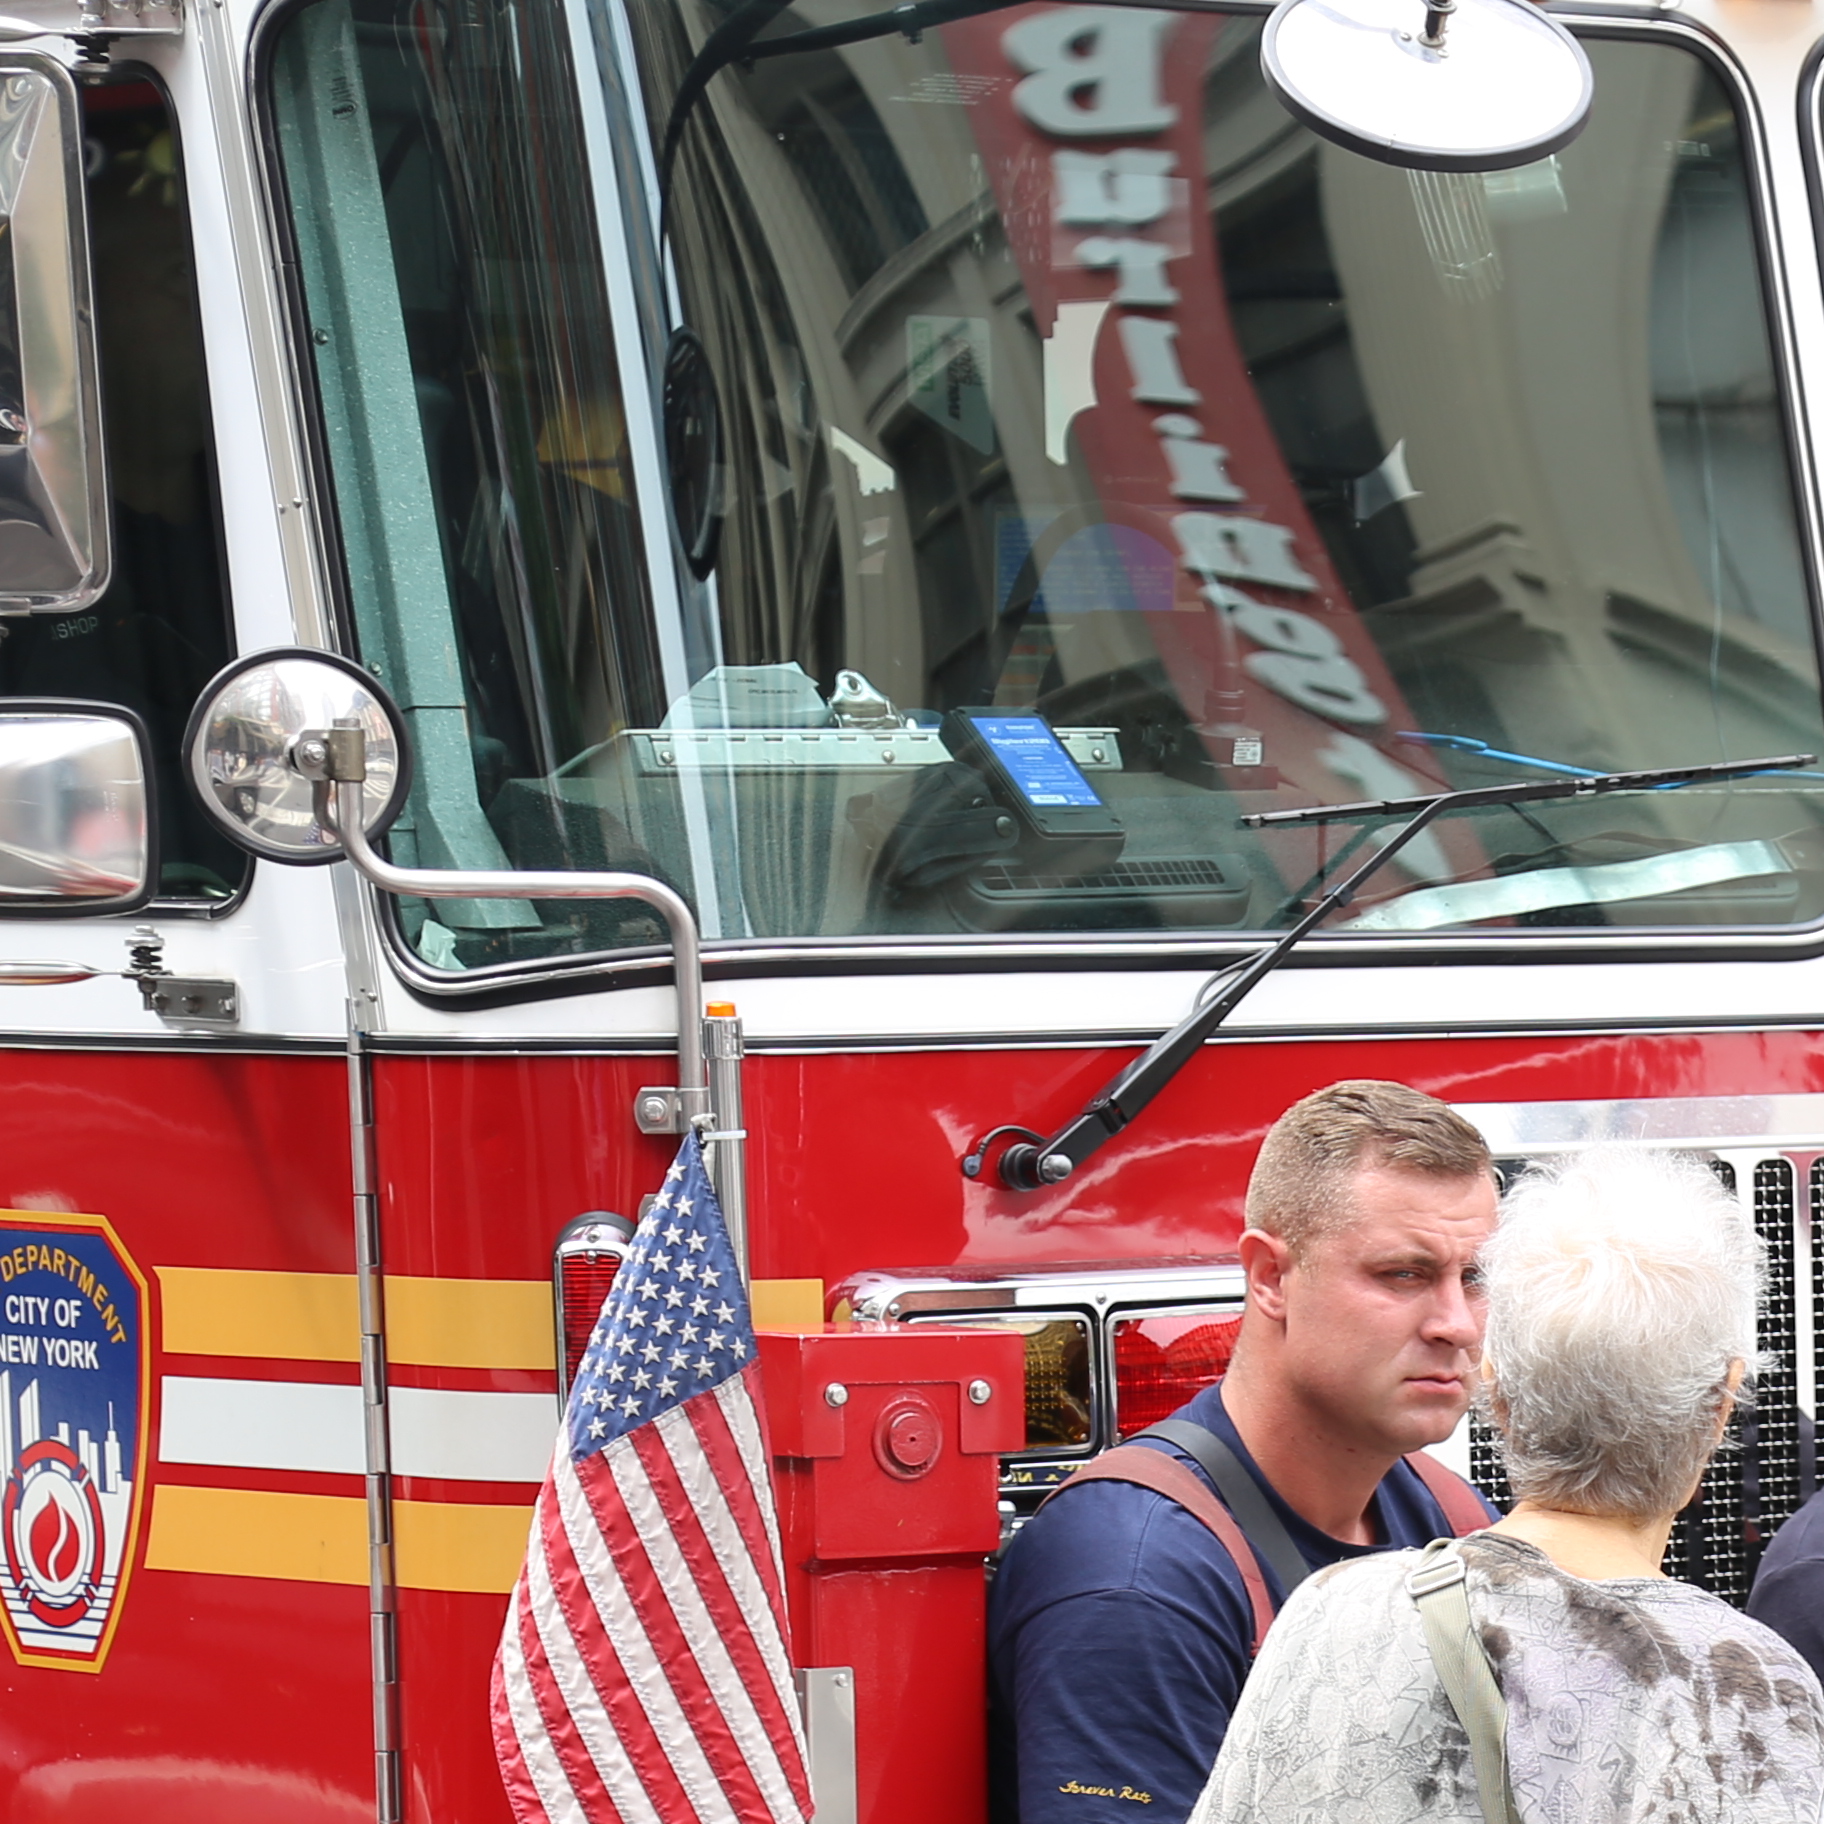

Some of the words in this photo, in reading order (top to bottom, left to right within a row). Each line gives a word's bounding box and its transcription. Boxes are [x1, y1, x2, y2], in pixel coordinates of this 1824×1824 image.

[0, 1244, 127, 1344] DEPARTMENT
[5, 1294, 50, 1326] CITY
[54, 1298, 82, 1328] OF
[42, 1336, 100, 1370] YORK
